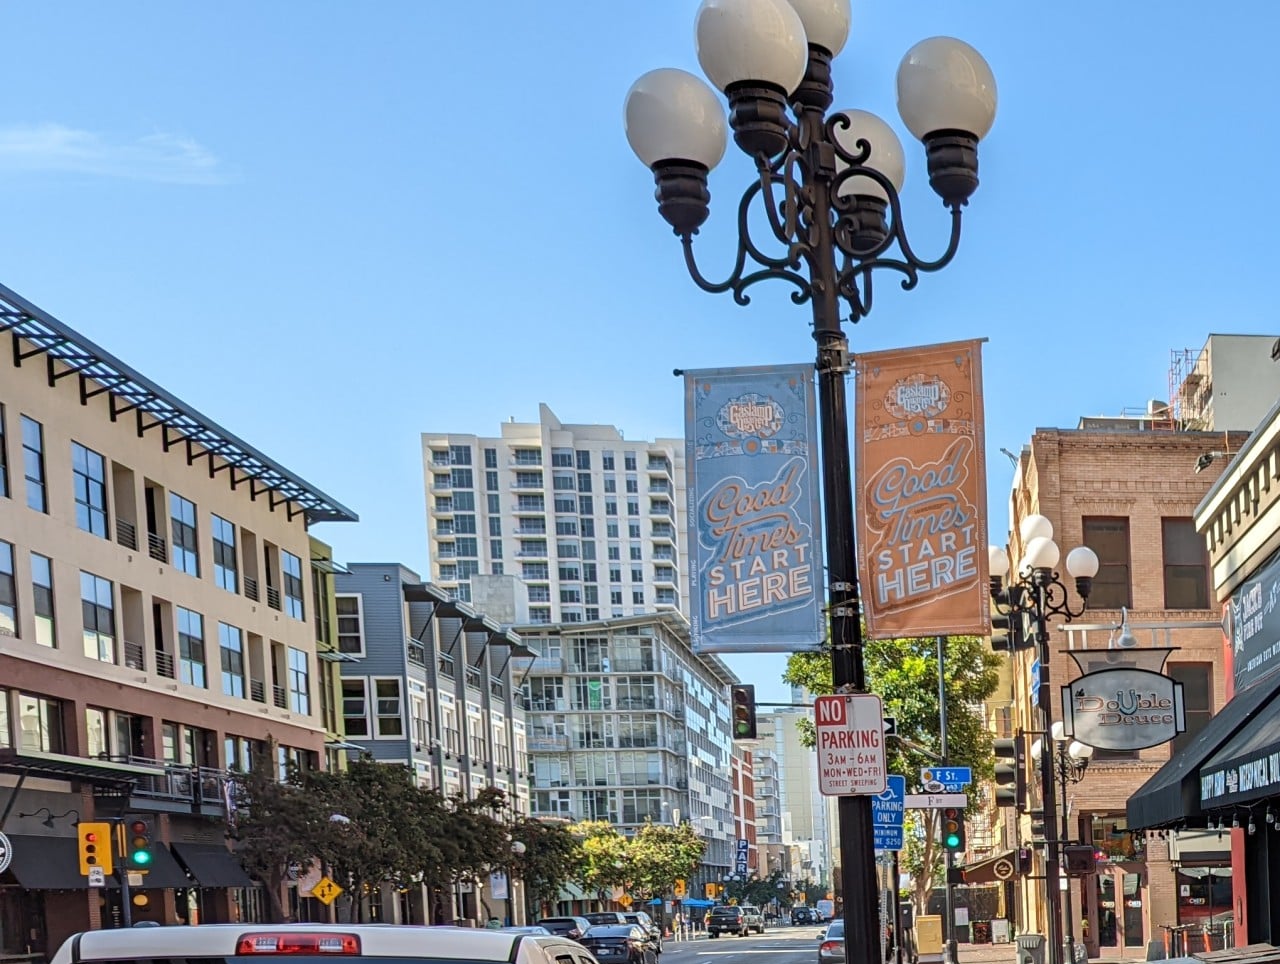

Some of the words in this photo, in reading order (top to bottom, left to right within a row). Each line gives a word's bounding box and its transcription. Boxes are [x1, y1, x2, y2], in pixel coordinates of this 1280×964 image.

[874, 443, 966, 504] Good
[707, 466, 800, 525] Good
[880, 494, 970, 547] Times
[713, 512, 805, 564] Times
[878, 524, 975, 569] START
[709, 542, 810, 586] START
[877, 545, 978, 605] HERE
[709, 564, 813, 619] HERE
[820, 700, 842, 722] NO
[1098, 712, 1174, 727] Deuce
[822, 729, 879, 750] PARKING
[827, 752, 847, 766] 3AM
[857, 752, 877, 765] 6AM
[829, 779, 848, 788] STREET
[850, 778, 877, 787] SWEEPING
[936, 771, 942, 780] F
[872, 800, 903, 812] PARKING
[928, 796, 934, 806] F
[878, 812, 896, 823] ONLY
